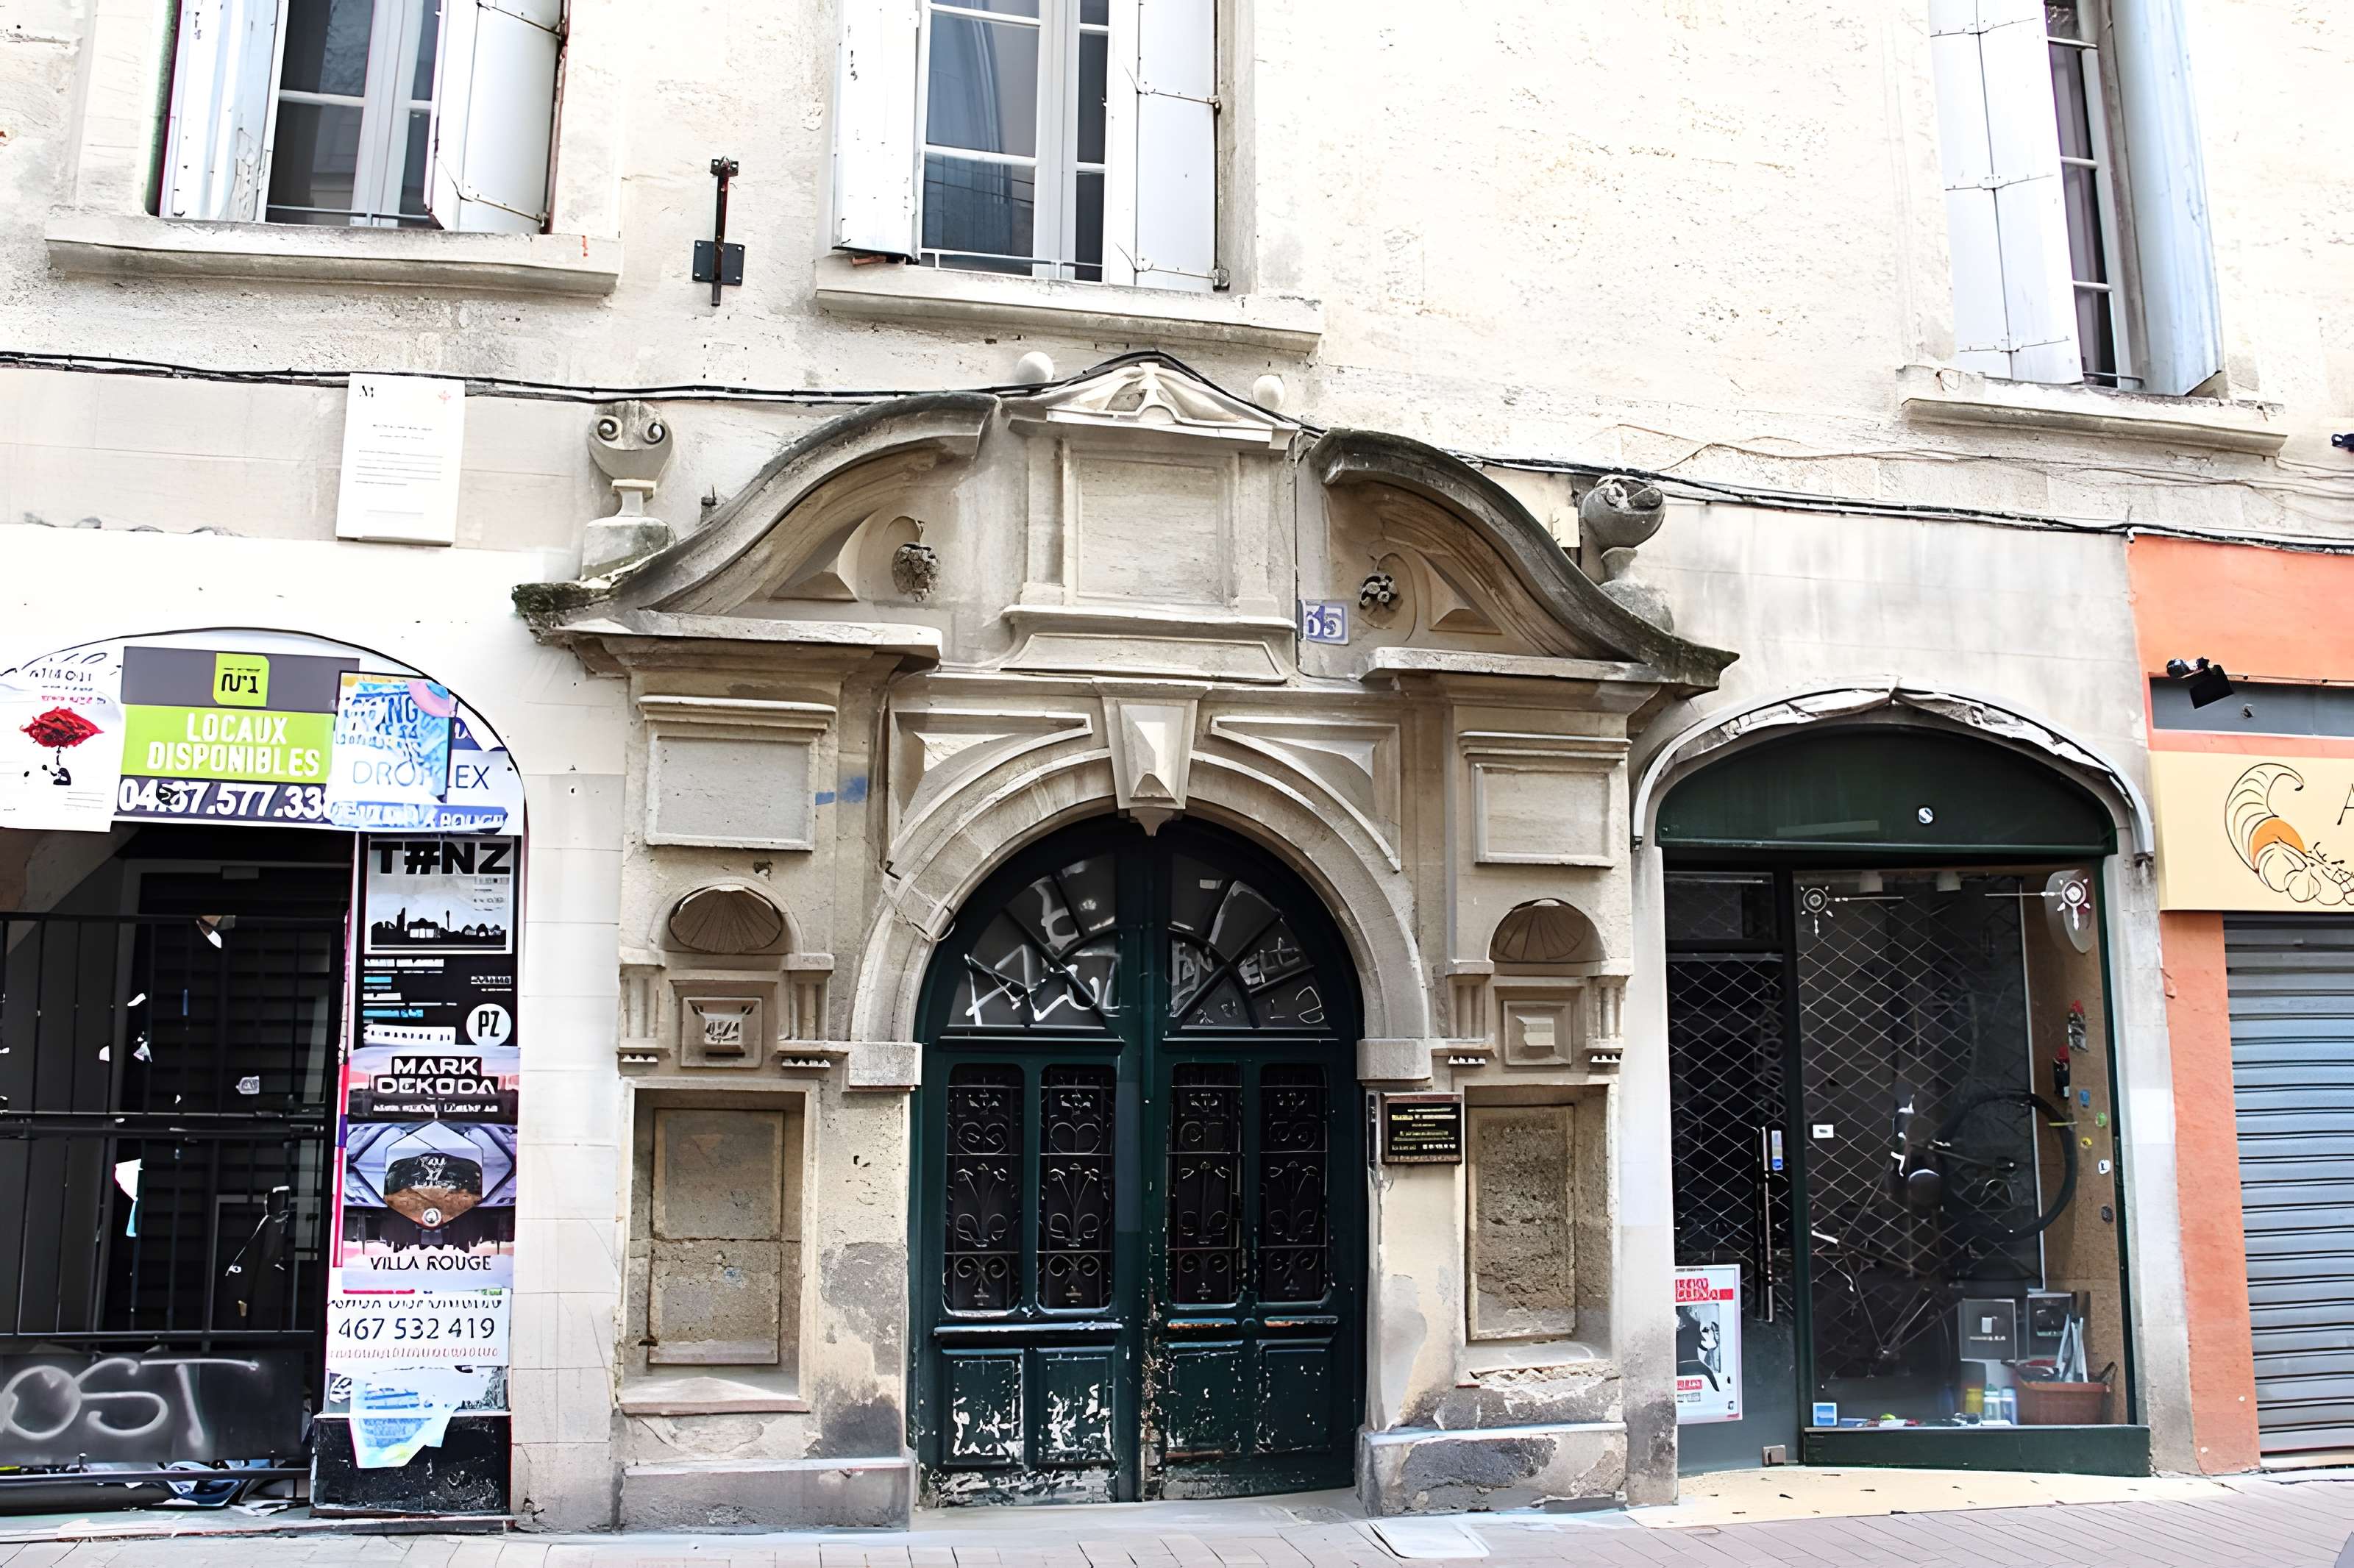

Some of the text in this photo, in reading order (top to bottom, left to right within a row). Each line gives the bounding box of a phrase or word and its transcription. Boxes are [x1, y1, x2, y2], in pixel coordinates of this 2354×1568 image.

[186, 713, 288, 745] LOCAUX
[146, 741, 321, 777] DISPONIBLES
[477, 1011, 500, 1038] PZ
[394, 1058, 479, 1075] MARK
[377, 1077, 496, 1095] DEKODA
[370, 1255, 492, 1271] VILLA ROUGE
[394, 1317, 440, 1340] 532
[447, 1317, 495, 1339] 419
